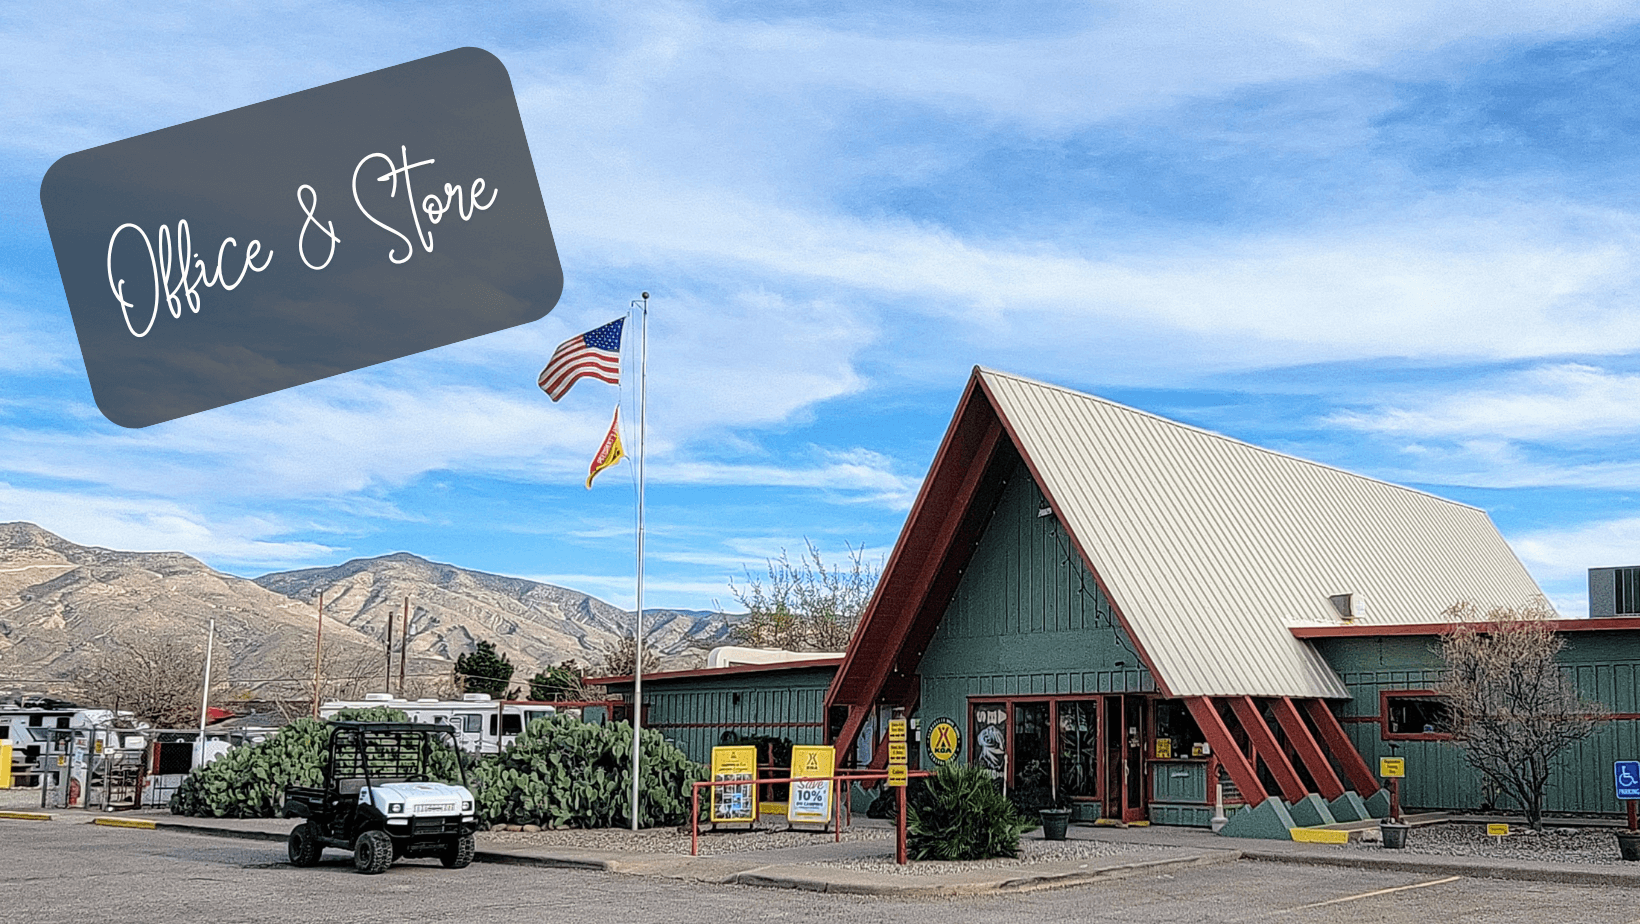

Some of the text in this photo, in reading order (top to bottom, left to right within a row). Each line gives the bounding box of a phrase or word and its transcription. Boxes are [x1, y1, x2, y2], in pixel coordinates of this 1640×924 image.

[797, 780, 824, 789] Save
[797, 790, 823, 801] 10%
[1618, 788, 1640, 796] PARKING
